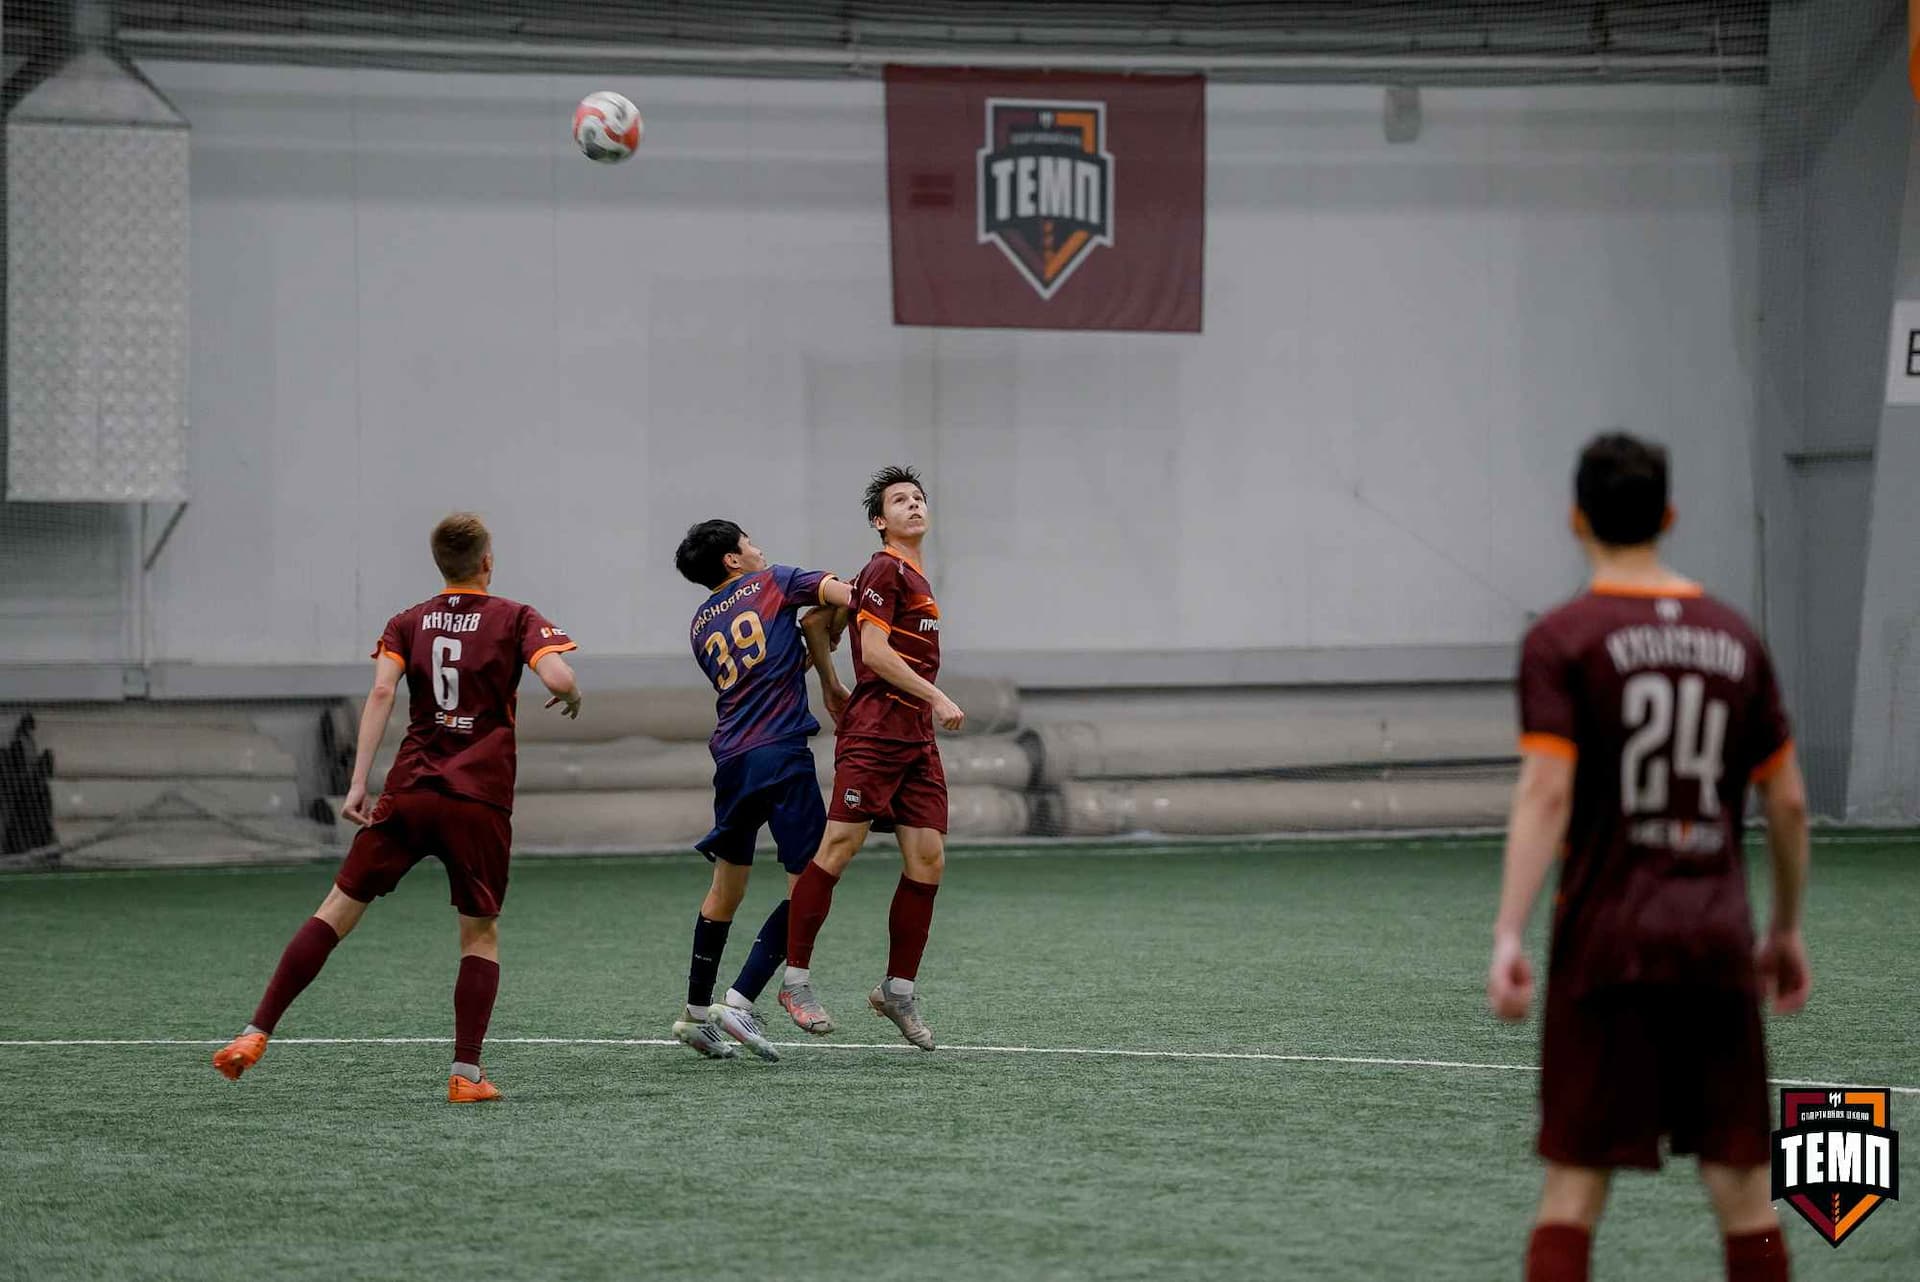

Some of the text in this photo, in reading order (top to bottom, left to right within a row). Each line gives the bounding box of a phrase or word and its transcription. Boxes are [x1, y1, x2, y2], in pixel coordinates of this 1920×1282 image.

[991, 156, 1100, 225] ТЕМП
[422, 611, 482, 633] КНЯЗЕВ
[704, 610, 767, 690] 39
[432, 635, 462, 711] 6
[1620, 671, 1730, 818] 24
